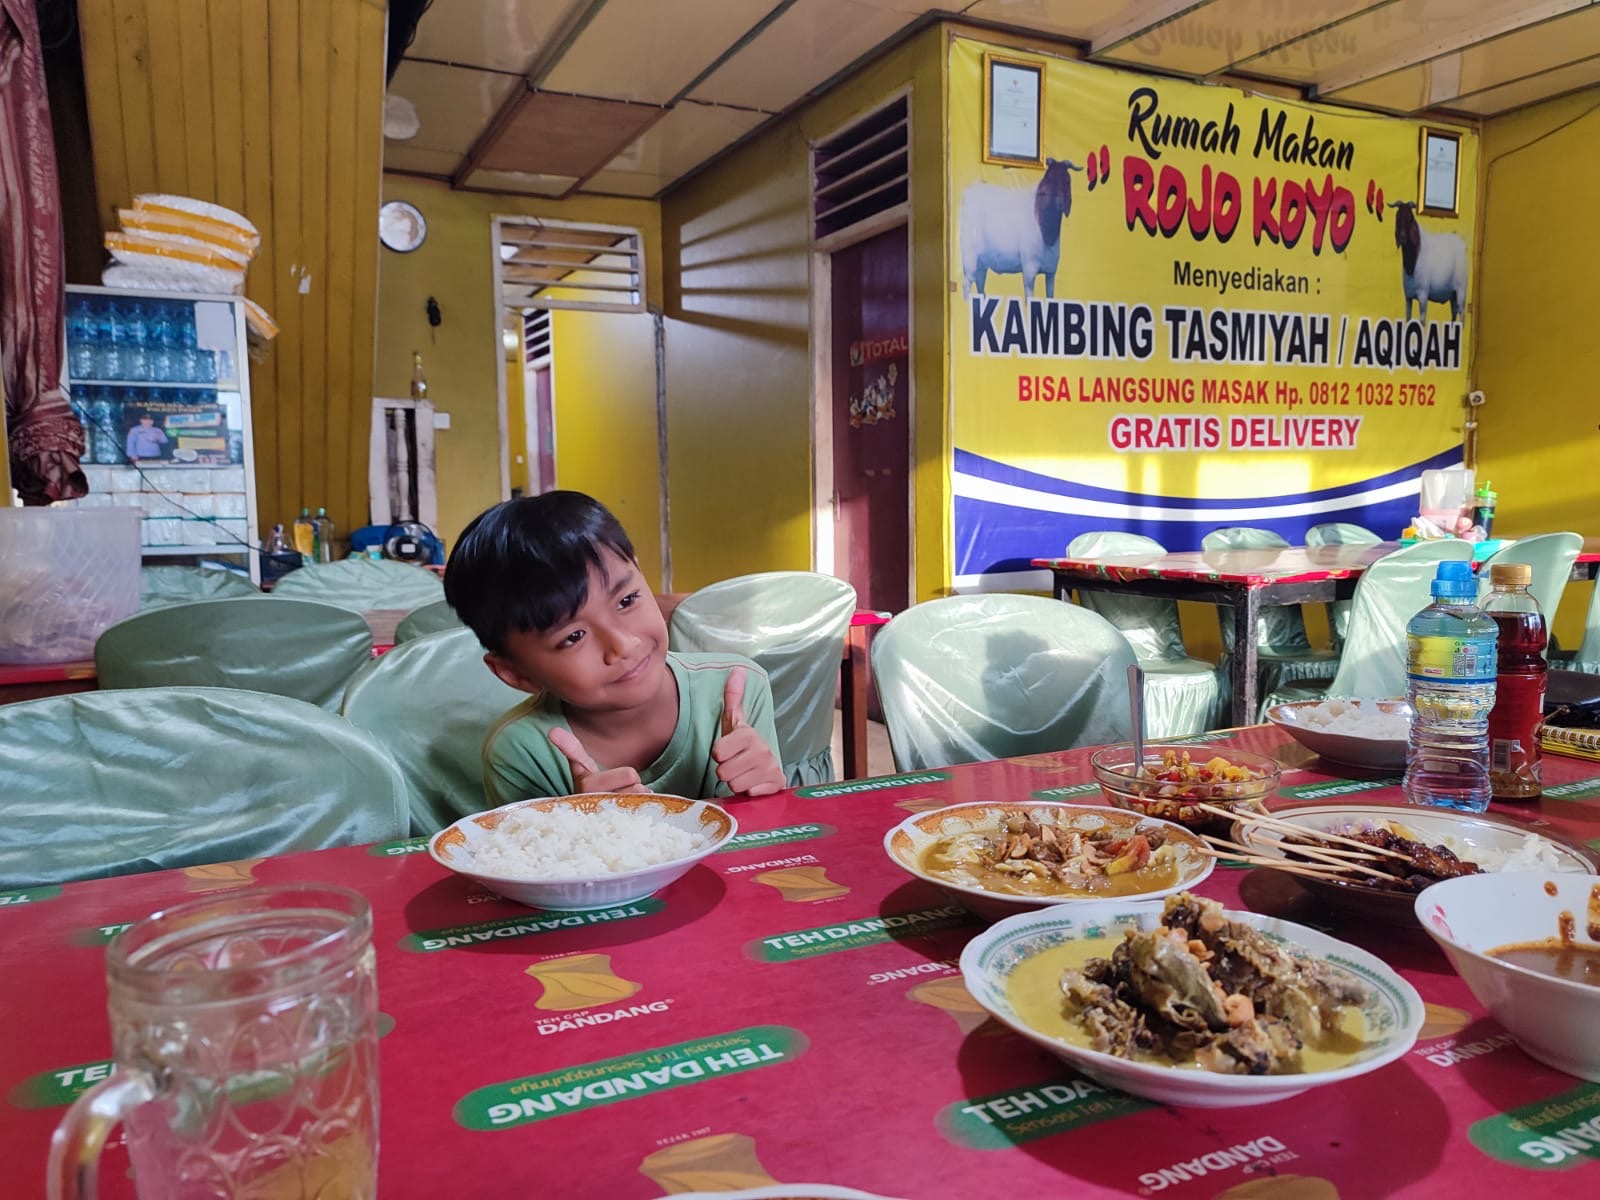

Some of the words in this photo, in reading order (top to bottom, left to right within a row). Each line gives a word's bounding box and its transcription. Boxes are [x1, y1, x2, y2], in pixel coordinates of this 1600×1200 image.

[1127, 87, 1240, 160] Rumah
[1254, 108, 1354, 171] Makan
[1123, 155, 1242, 244] ROJO
[1252, 173, 1355, 257] KOYO
[1173, 260, 1308, 294] Menyediakan
[864, 336, 908, 359] TOTAL
[971, 297, 1153, 359] KAMBING
[1164, 308, 1329, 365] TASMIYAH
[1353, 320, 1462, 370] AQIQAH
[1018, 375, 1072, 403] BISA
[1078, 376, 1195, 405] LANGSUNG
[1202, 379, 1269, 405] MASAK
[1275, 381, 1303, 411] Hp.
[1309, 382, 1350, 405] 0812
[1355, 384, 1393, 406] 1032
[1399, 385, 1436, 407] 5762
[1110, 417, 1220, 449] GRATIS
[1230, 417, 1361, 449] DELIVERY
[810, 781, 905, 797] DANDANG
[587, 906, 647, 923] TEH
[423, 915, 585, 950] DANDANG
[764, 931, 825, 951] TEH
[536, 1001, 670, 1036] DANDANG
[683, 1035, 751, 1058] Sensasi
[709, 1043, 784, 1073] TEH
[488, 1060, 705, 1124] DANDANG
[962, 1091, 1049, 1124] TEH
[1138, 1135, 1286, 1192] DANDANG
